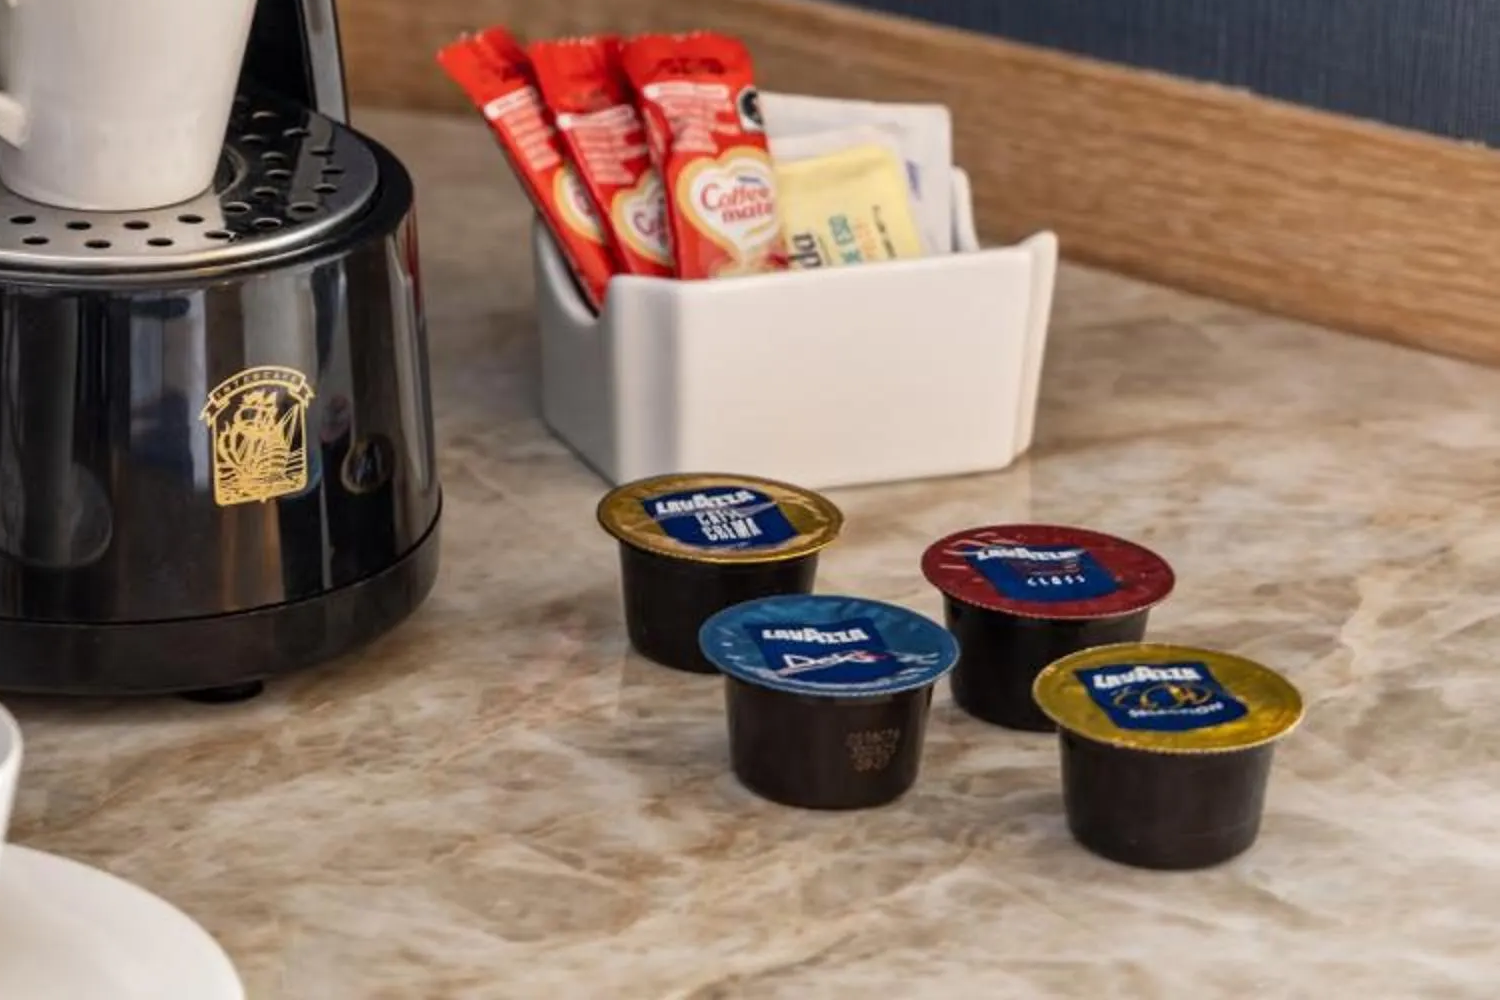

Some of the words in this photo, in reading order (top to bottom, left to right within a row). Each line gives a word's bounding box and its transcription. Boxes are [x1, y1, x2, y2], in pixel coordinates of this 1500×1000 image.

[700, 183, 771, 211] Coffee
[654, 490, 757, 515] LAVAZZA
[702, 517, 764, 541] CREMA
[761, 627, 870, 645] LAVAZZA
[1092, 666, 1203, 689] LAVAZZA
